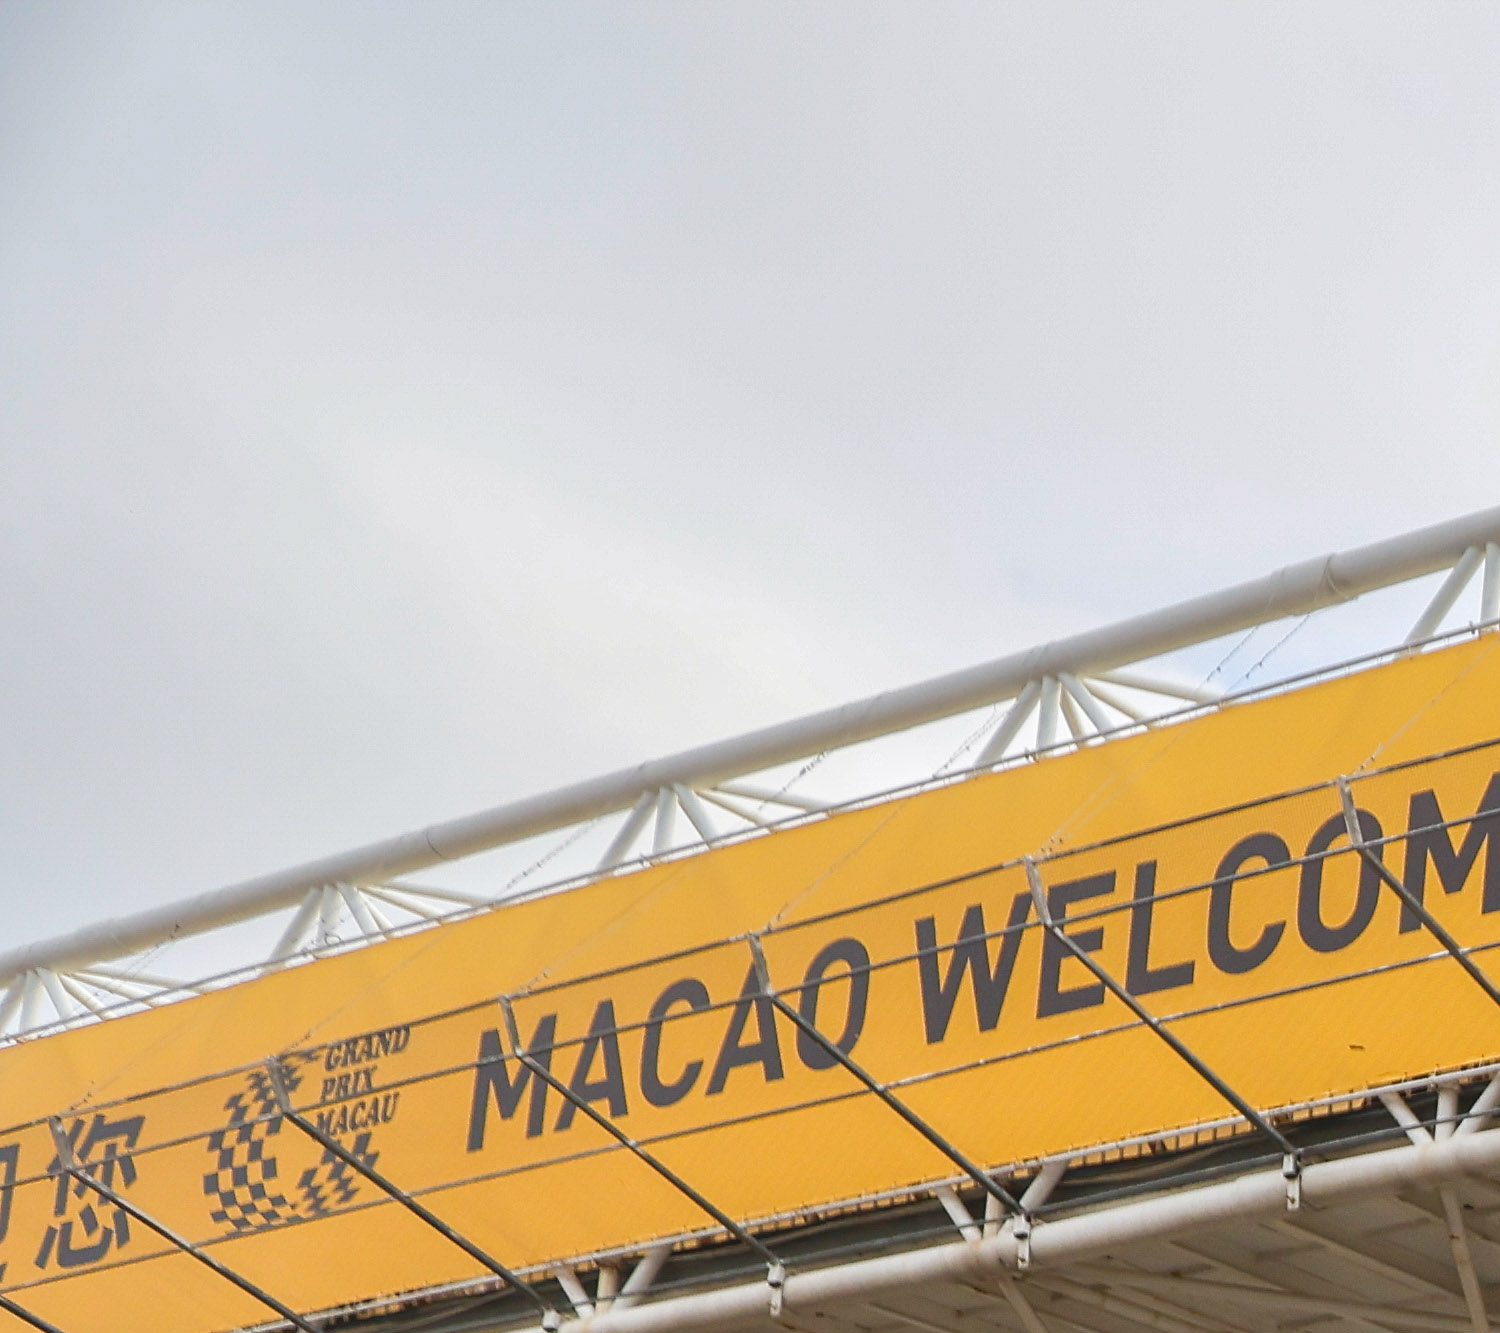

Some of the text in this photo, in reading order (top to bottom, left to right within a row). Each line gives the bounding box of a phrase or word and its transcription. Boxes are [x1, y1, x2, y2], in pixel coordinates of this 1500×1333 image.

[325, 1025, 411, 1071] GRAND
[467, 936, 870, 1153] MACAO
[320, 1064, 378, 1102] PRIX
[317, 1092, 400, 1136] MACAU
